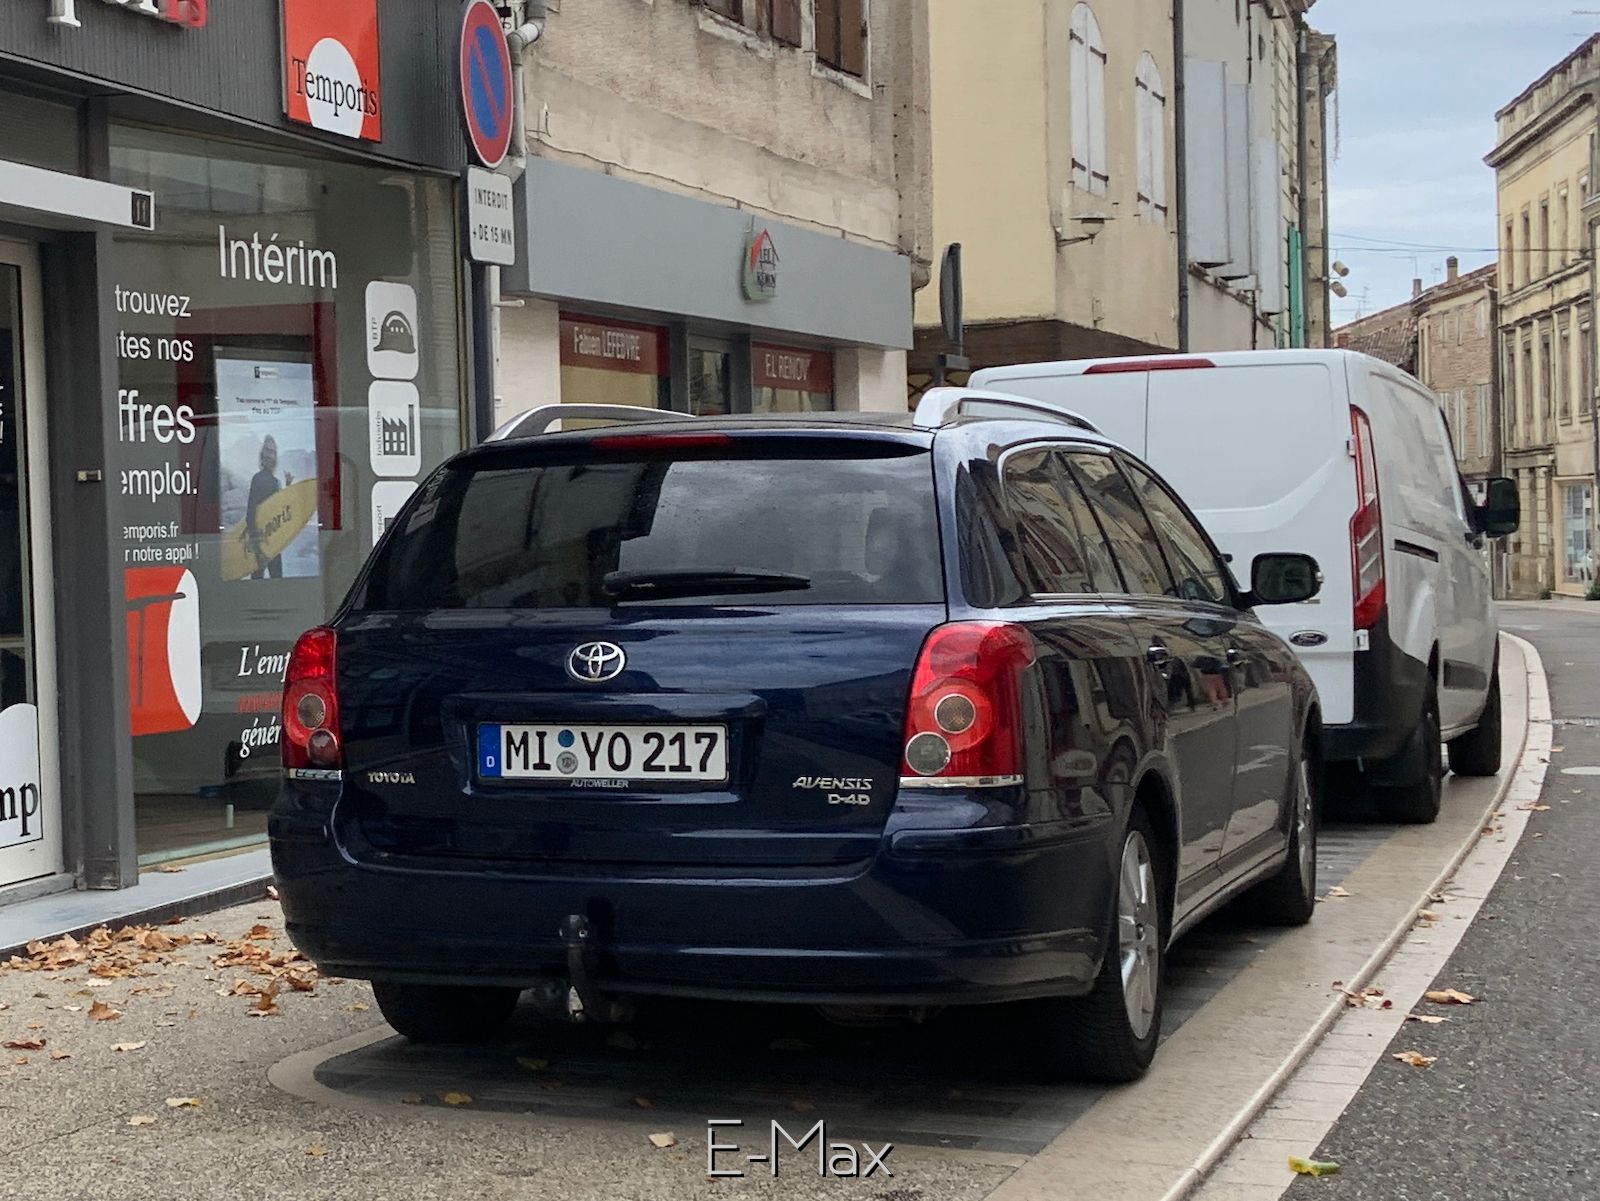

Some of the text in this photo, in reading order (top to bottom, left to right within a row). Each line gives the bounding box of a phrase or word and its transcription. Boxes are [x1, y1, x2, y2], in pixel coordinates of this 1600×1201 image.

[292, 56, 377, 117] Temporis
[474, 187, 508, 210] INTERDIT
[479, 223, 489, 242] DE
[490, 225, 499, 243] 15
[500, 227, 512, 245] MN
[219, 225, 338, 289] Intérim
[115, 284, 192, 318] trouvez
[117, 330, 194, 362] tes nos
[132, 546, 163, 561] notre
[165, 544, 192, 564] appli
[486, 756, 496, 768] D
[505, 730, 718, 773] MI YO 217
[368, 771, 416, 784] TOYOTA
[570, 779, 629, 789] AUTOWELLER
[792, 777, 873, 790] AVENSIS
[828, 794, 871, 805] D-4D
